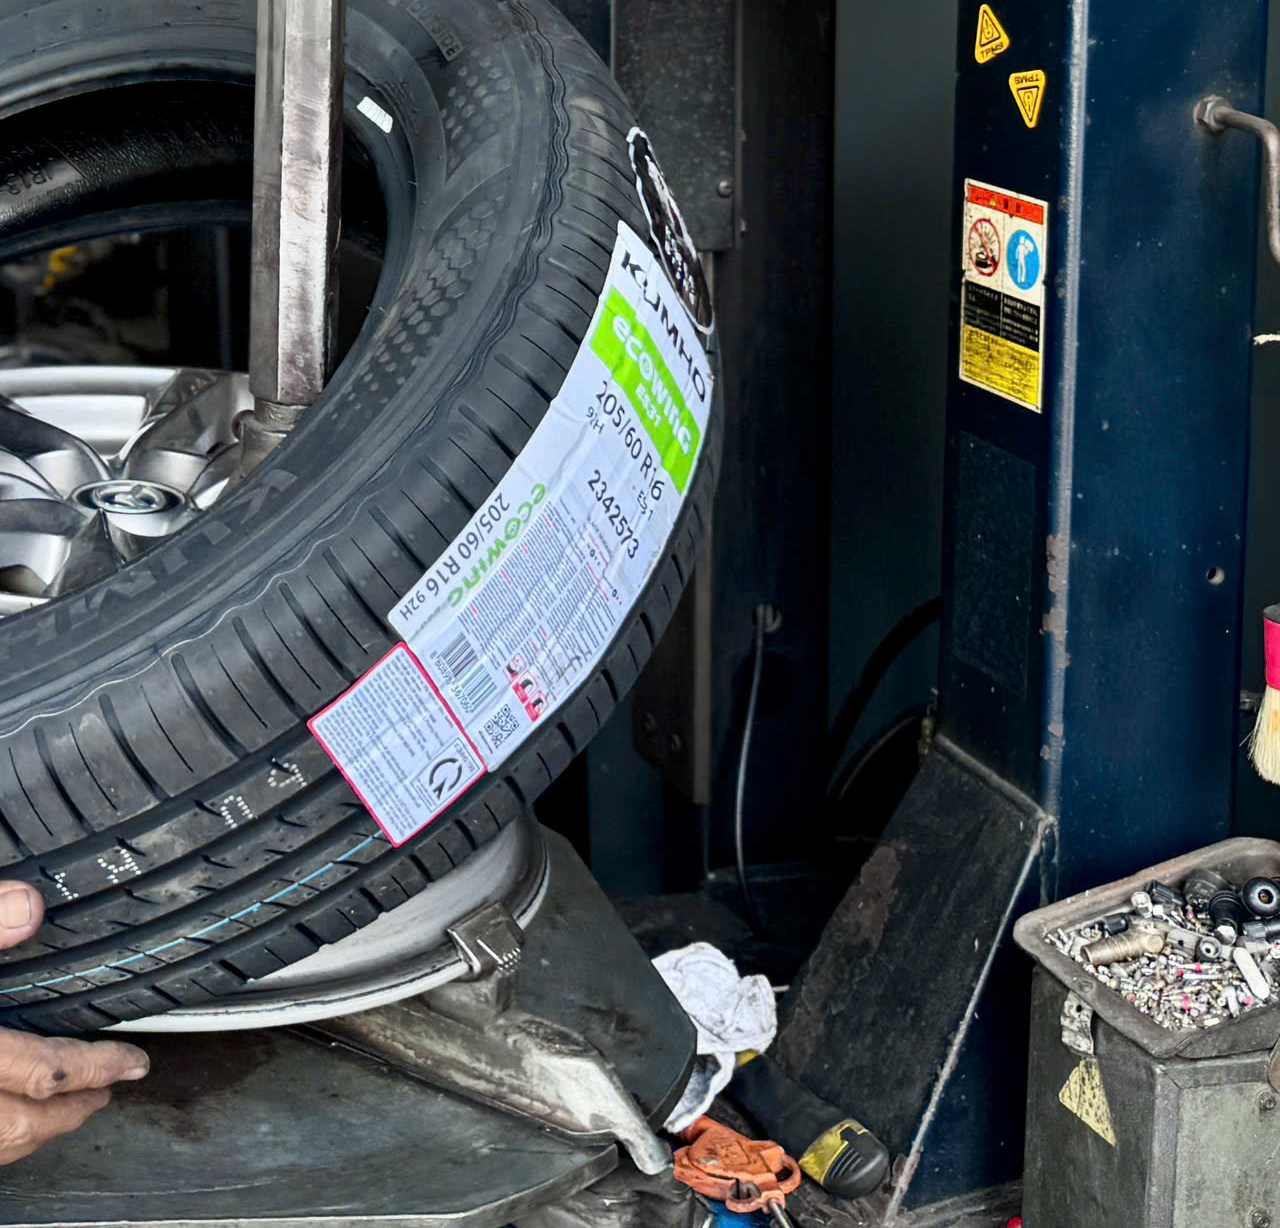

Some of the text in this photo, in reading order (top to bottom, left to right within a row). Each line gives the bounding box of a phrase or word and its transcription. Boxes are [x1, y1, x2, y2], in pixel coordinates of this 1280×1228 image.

[980, 42, 1004, 59] TPMS
[1014, 74, 1040, 85] TPMS
[621, 250, 706, 403] KUMHO
[399, 492, 511, 621] 205/60 R16 92H
[587, 469, 640, 559] 2342573
